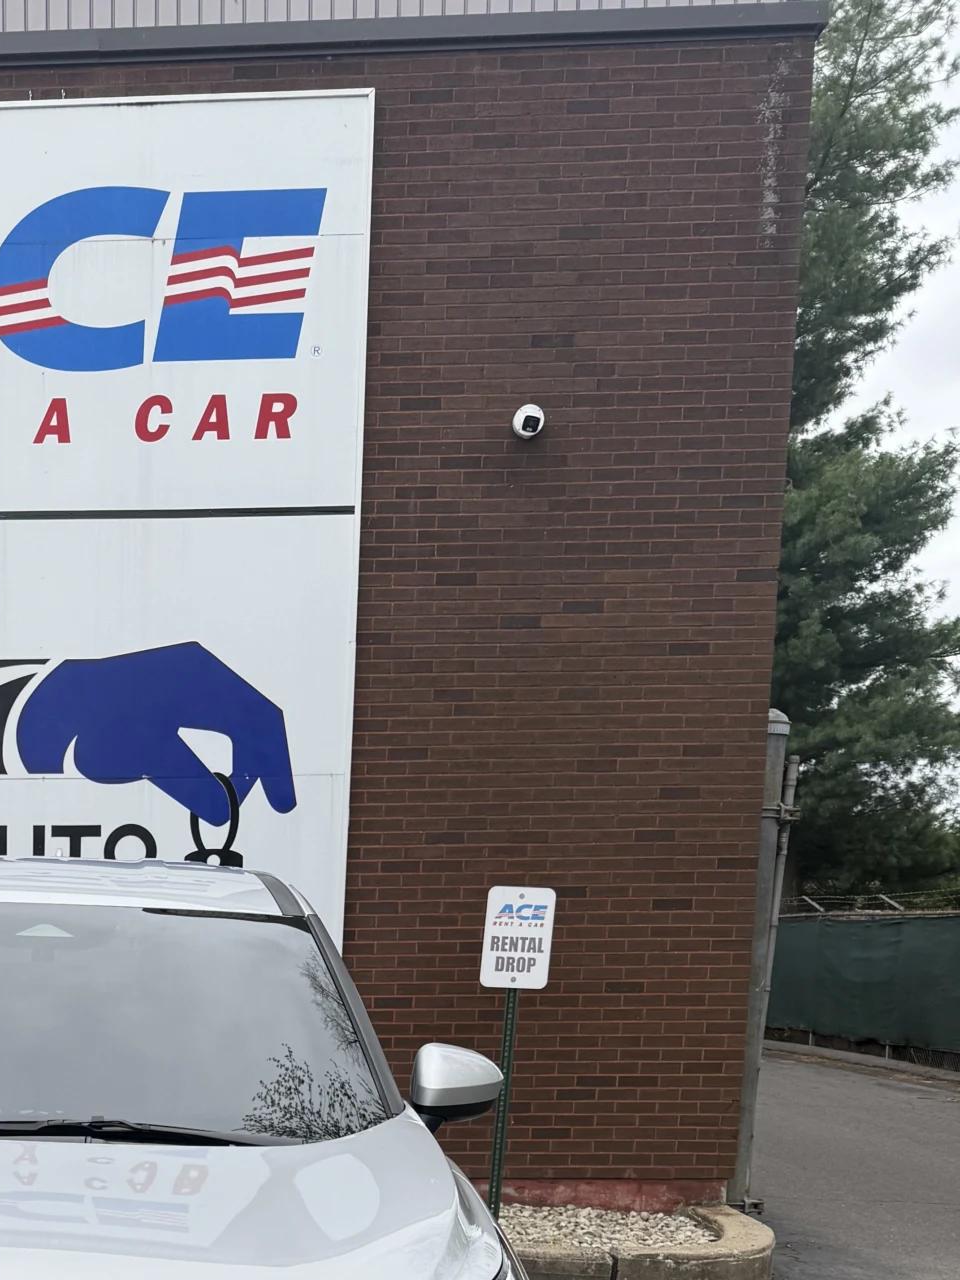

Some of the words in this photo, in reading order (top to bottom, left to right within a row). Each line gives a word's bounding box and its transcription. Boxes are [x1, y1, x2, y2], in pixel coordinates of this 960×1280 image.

[32, 397, 73, 445] A
[134, 392, 299, 443] CAR
[494, 903, 548, 921] ACE
[490, 935, 544, 954] RENTAL
[494, 956, 537, 973] DROP
